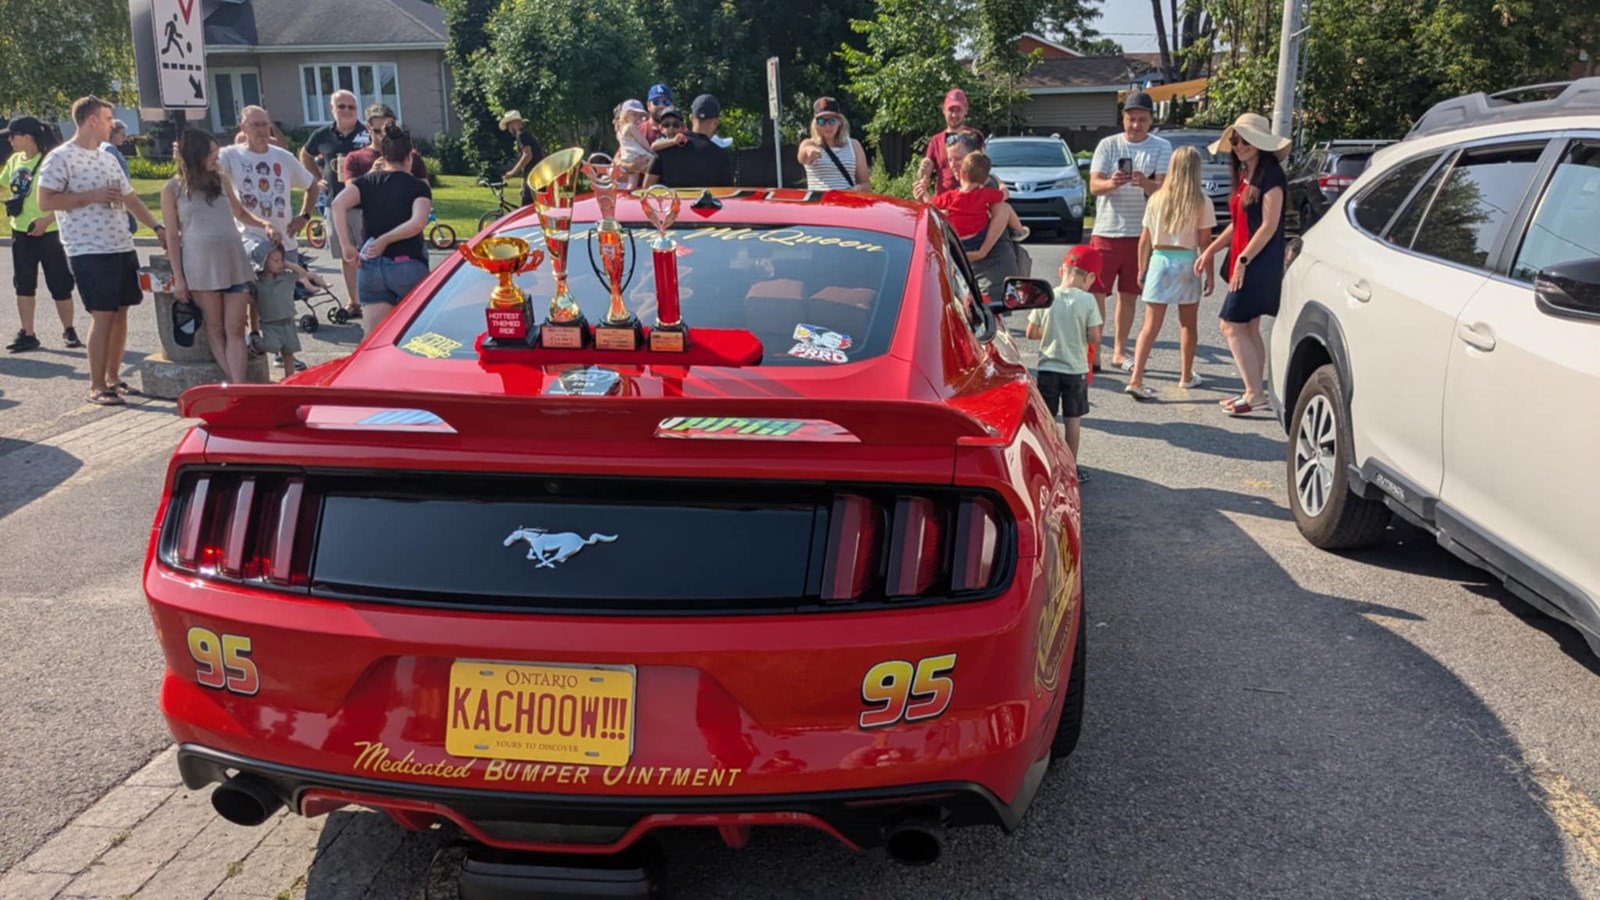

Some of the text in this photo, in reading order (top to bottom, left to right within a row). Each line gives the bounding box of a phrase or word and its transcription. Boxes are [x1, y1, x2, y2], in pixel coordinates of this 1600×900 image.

[488, 312, 520, 320] HOTTEST
[492, 319, 521, 328] THEMED
[498, 327, 516, 335] RIDE
[186, 626, 260, 696] 95
[504, 668, 579, 690] ONTARIO
[858, 652, 958, 731] 95
[451, 686, 629, 741] KACHOOW!!!
[495, 739, 580, 753] YOURS TO DISCOVER
[352, 740, 478, 779] Medicated
[483, 758, 591, 785] BUMPER
